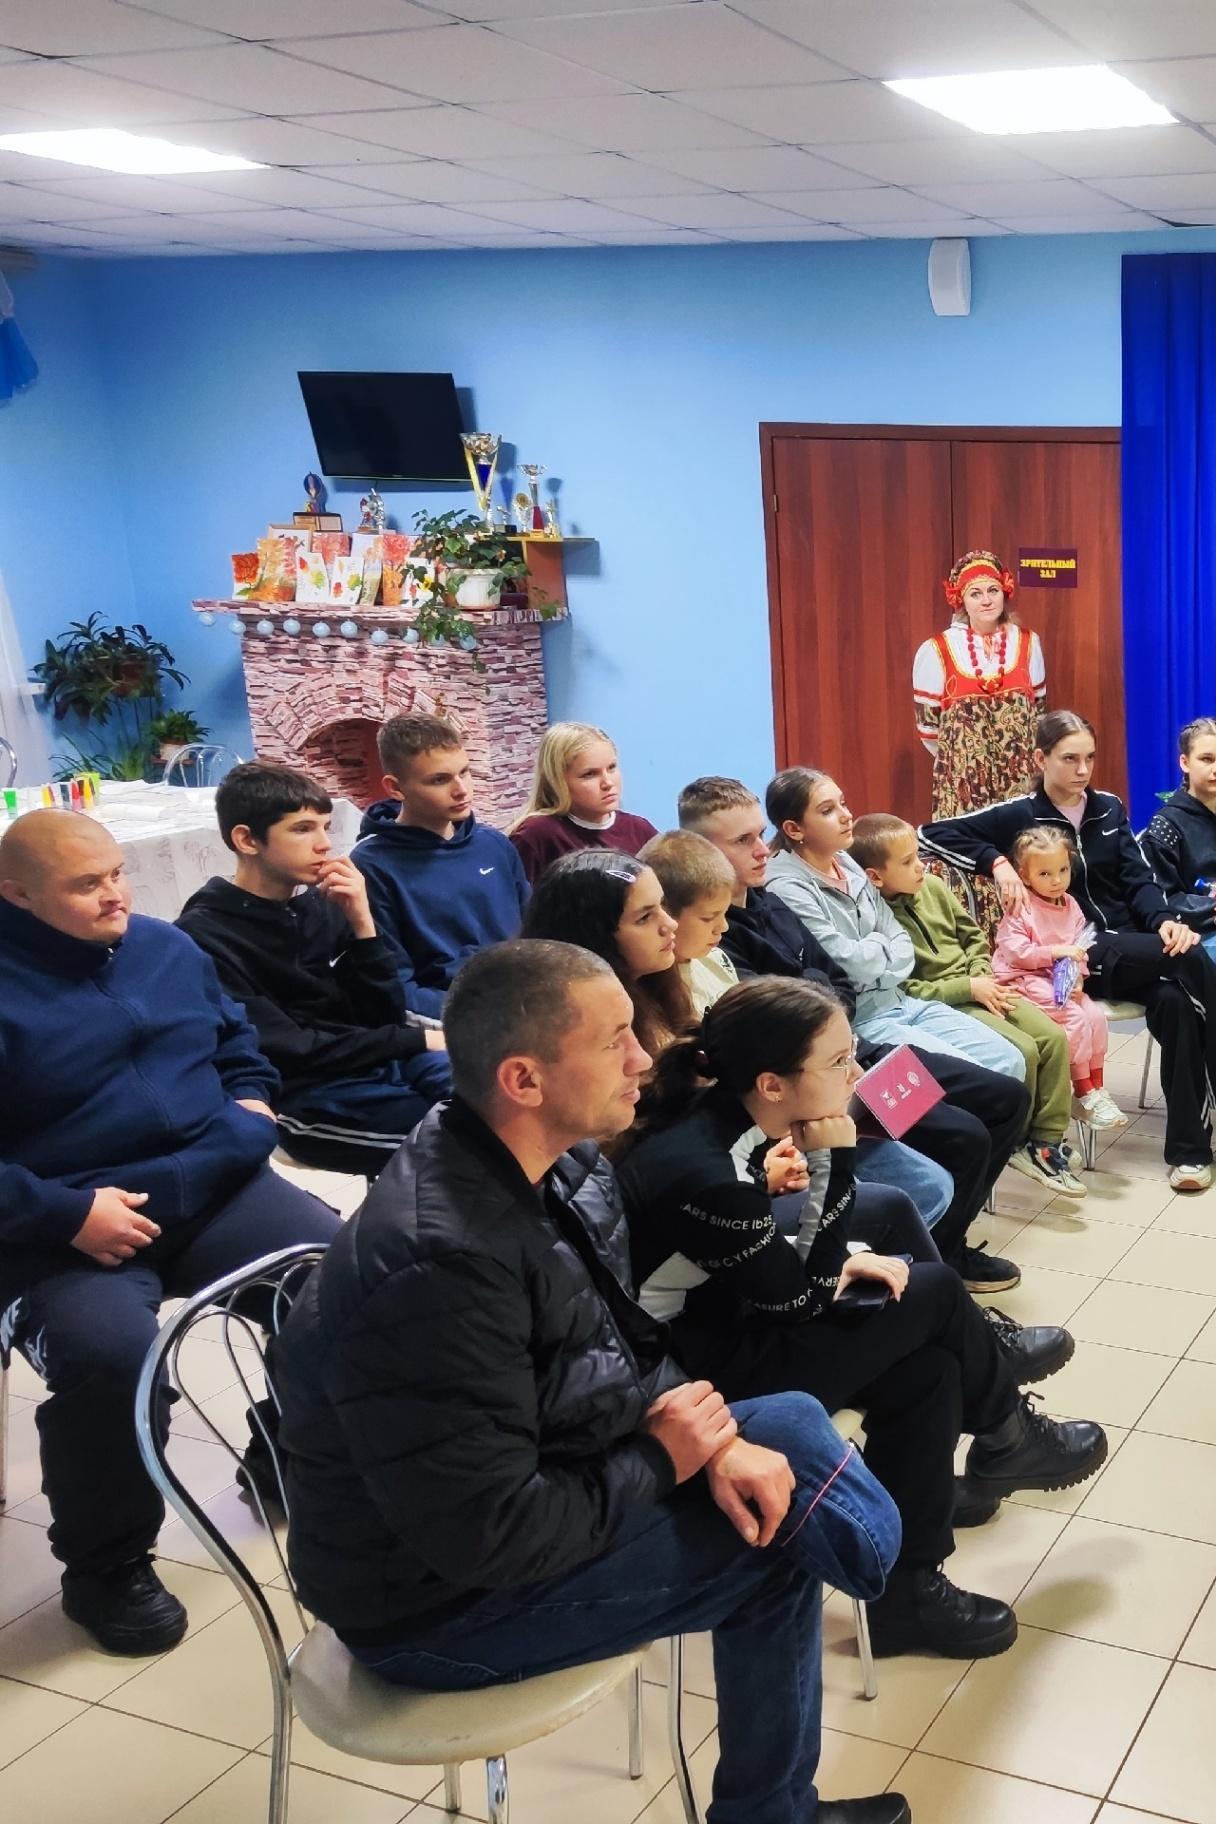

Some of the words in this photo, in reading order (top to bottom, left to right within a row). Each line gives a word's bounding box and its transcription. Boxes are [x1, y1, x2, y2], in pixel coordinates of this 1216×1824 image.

[1020, 558, 1076, 569] ЗРИТЕЛЬНЫЙ
[1040, 569, 1056, 578] ЗАЛ
[680, 1203, 707, 1221] ARS
[709, 1215, 749, 1230] SINCE
